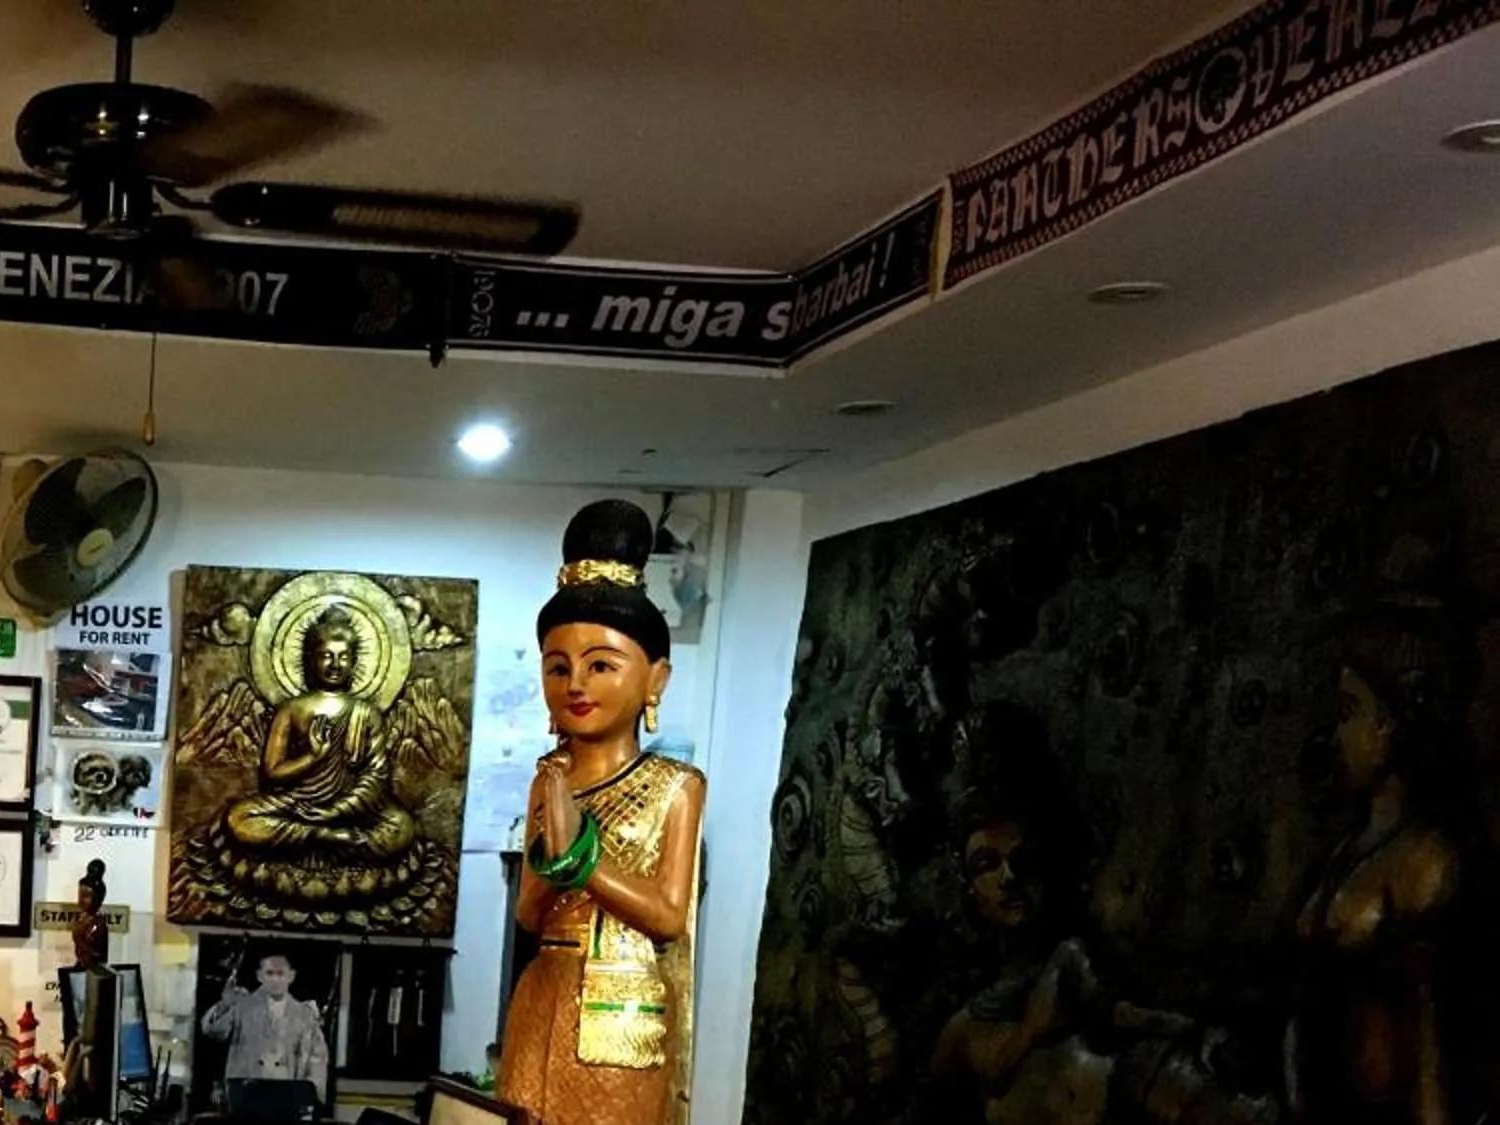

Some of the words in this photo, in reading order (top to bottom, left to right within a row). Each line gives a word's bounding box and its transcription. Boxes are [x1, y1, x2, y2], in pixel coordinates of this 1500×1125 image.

[590, 284, 746, 349] miga
[70, 605, 163, 630] HOUSE
[80, 630, 109, 645] FOR
[113, 631, 151, 645] RENT
